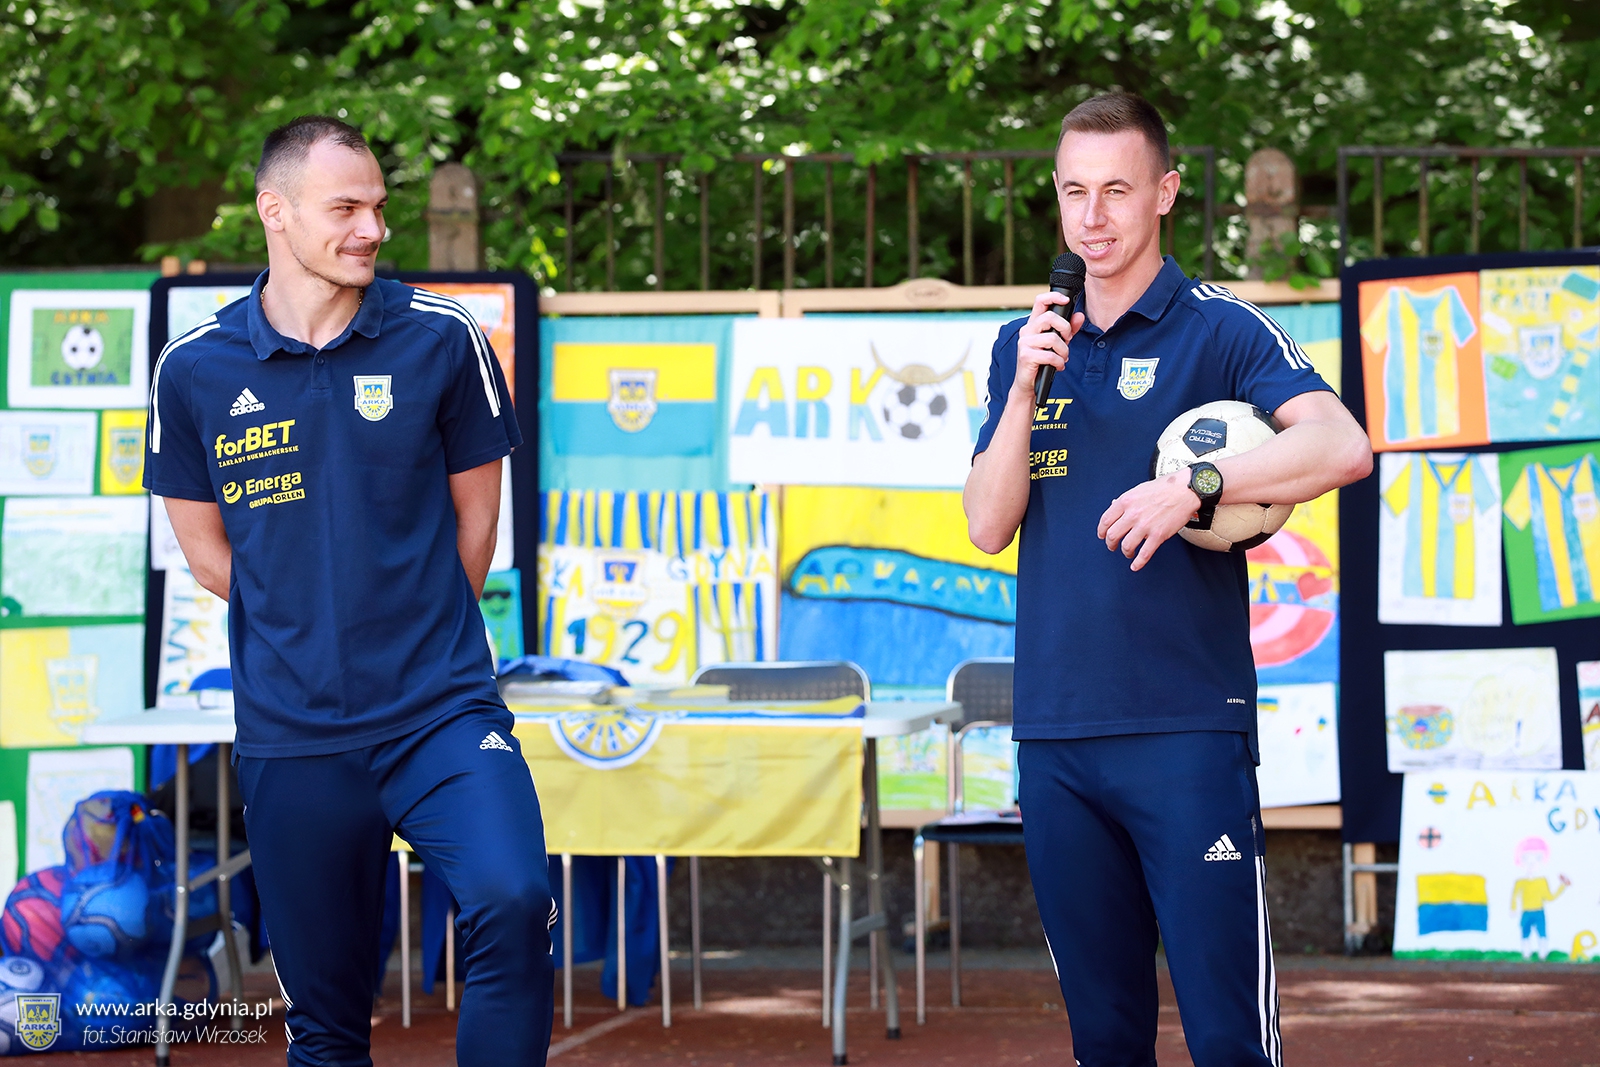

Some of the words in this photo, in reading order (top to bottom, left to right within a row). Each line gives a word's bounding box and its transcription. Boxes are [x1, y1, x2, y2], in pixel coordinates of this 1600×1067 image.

[229, 402, 266, 417] adidas
[214, 419, 296, 459] forBET
[1188, 435, 1217, 445] RETRO
[218, 456, 246, 468] ZAKŁADY
[246, 445, 300, 462] BUKMACHERSKIE
[1040, 468, 1066, 476] ORLEN
[245, 472, 302, 496] Energa
[249, 498, 273, 509] GRUPA
[275, 490, 303, 503] ORLEN
[567, 610, 686, 672] 1929
[479, 743, 514, 752] adidas
[1204, 850, 1242, 861] adidas
